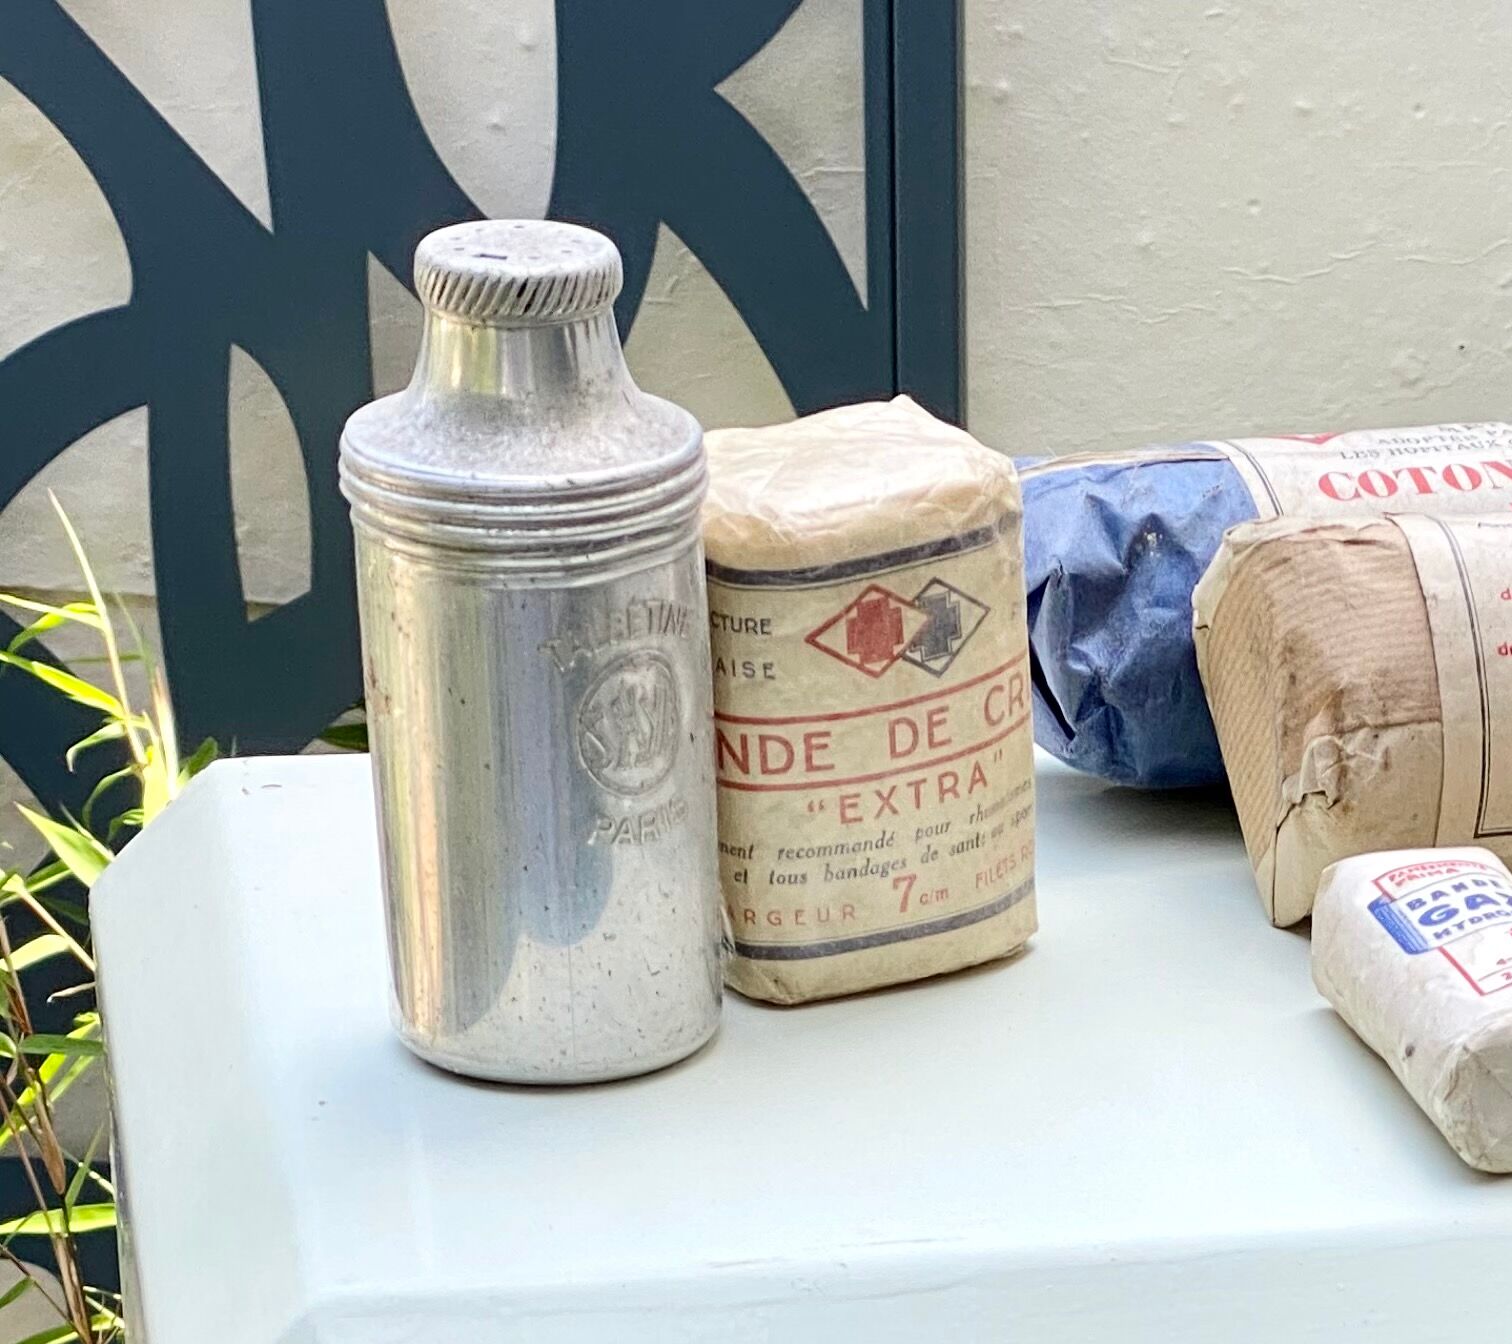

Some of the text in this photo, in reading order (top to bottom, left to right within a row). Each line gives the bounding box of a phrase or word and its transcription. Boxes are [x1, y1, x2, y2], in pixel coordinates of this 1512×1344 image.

[887, 705, 953, 760] DE
[776, 829, 896, 862] recommandé
[914, 819, 953, 842] pour
[733, 867, 749, 886] et
[768, 869, 808, 886] tous
[822, 855, 908, 884] bandages
[919, 844, 940, 865] de
[892, 873, 918, 914] 7
[1406, 878, 1504, 912] BANDE
